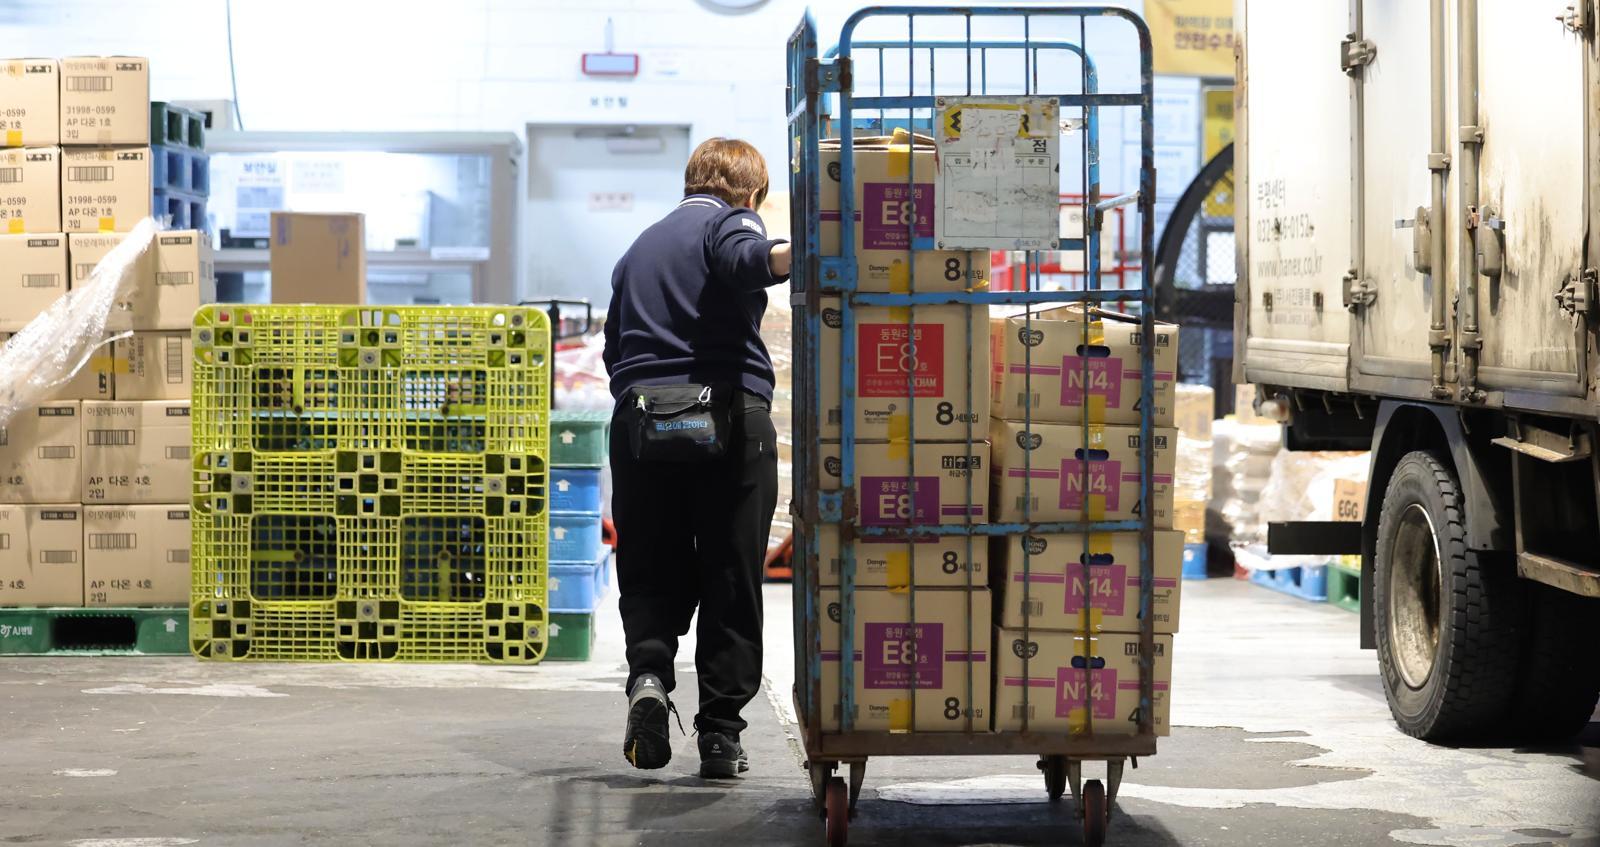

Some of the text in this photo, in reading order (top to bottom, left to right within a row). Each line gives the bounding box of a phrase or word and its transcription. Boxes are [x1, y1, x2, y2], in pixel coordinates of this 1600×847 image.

[66, 106, 116, 114] 31998-0599
[100, 118, 112, 127] 1호
[66, 130, 79, 139] 3입
[68, 196, 117, 204] 31998-0599
[68, 208, 80, 216] AP
[101, 208, 112, 216] 1호
[68, 220, 80, 229] 3입
[87, 407, 135, 416] 아모레퍼시픽
[88, 476, 152, 486] AP 다온 4호
[88, 489, 104, 499] 2입
[1338, 500, 1358, 519] EGG
[88, 511, 136, 520] 아모레퍼시픽
[9, 580, 26, 590] 4호
[90, 580, 152, 590] AP 다온 4호
[90, 592, 106, 602] 2입
